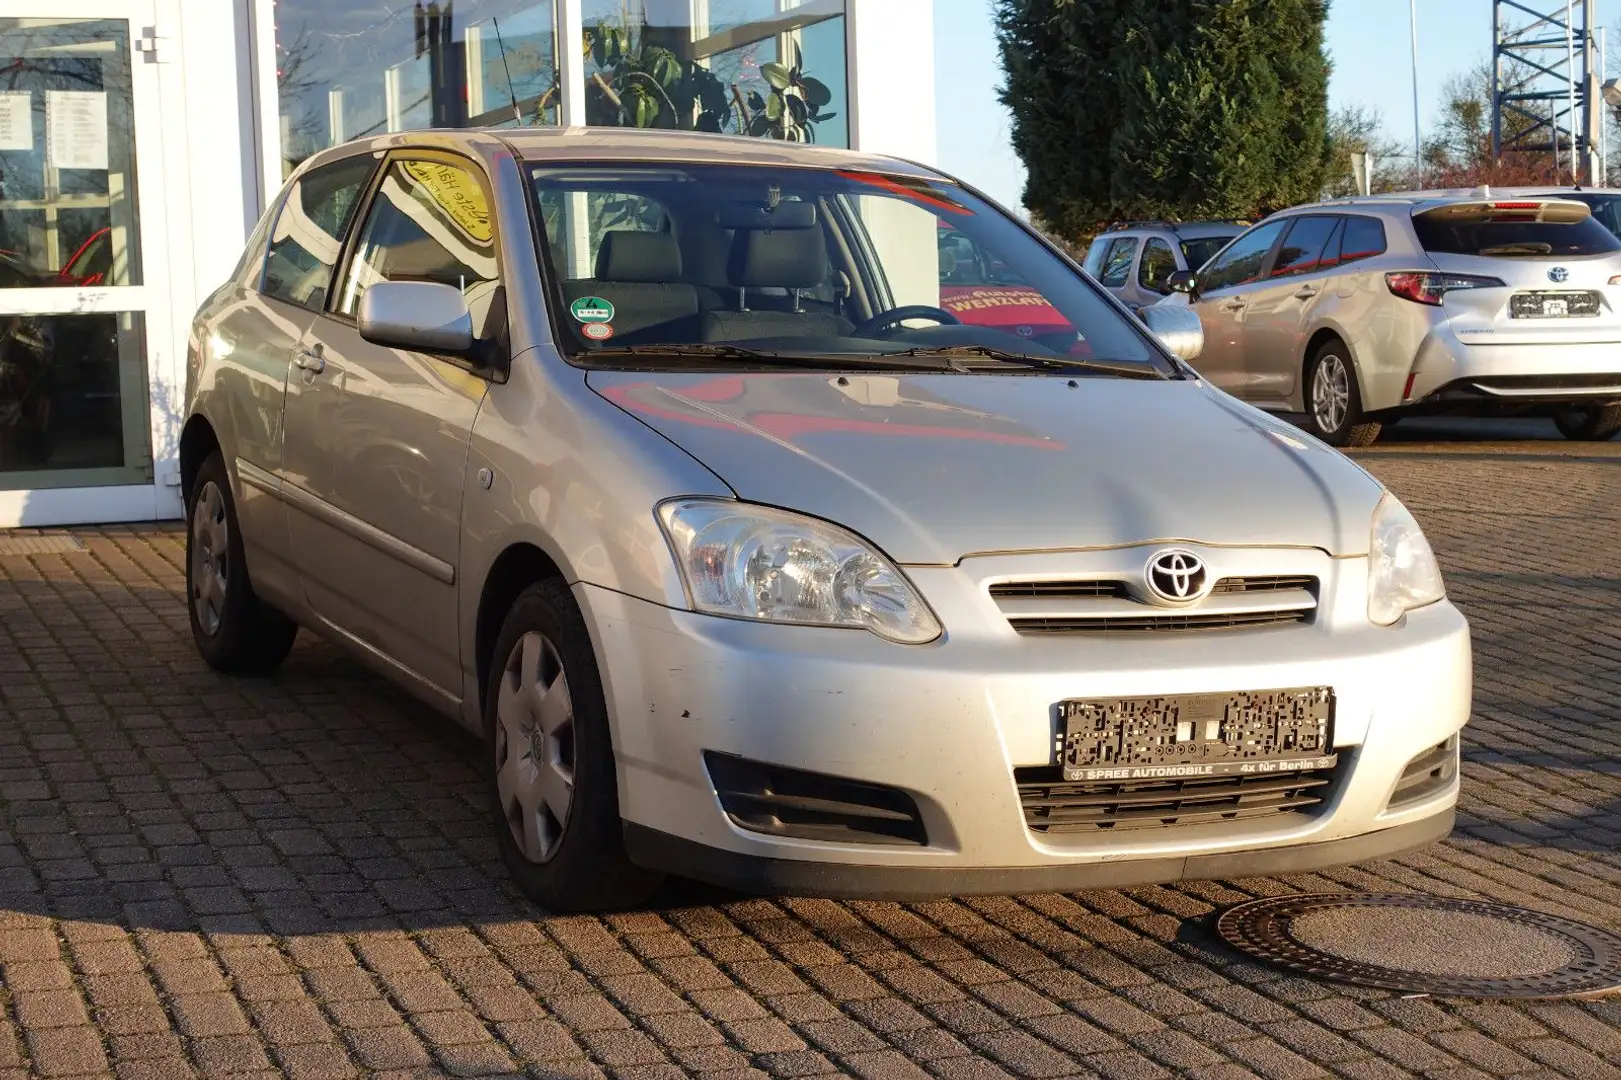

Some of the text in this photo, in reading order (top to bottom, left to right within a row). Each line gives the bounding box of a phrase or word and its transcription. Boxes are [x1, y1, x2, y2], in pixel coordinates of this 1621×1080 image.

[1087, 769, 1130, 780] SPREE
[1132, 765, 1213, 778] AUTOMOBILE
[1240, 764, 1256, 772] 4x
[1259, 762, 1276, 772] für
[1279, 760, 1314, 771] Berlin
